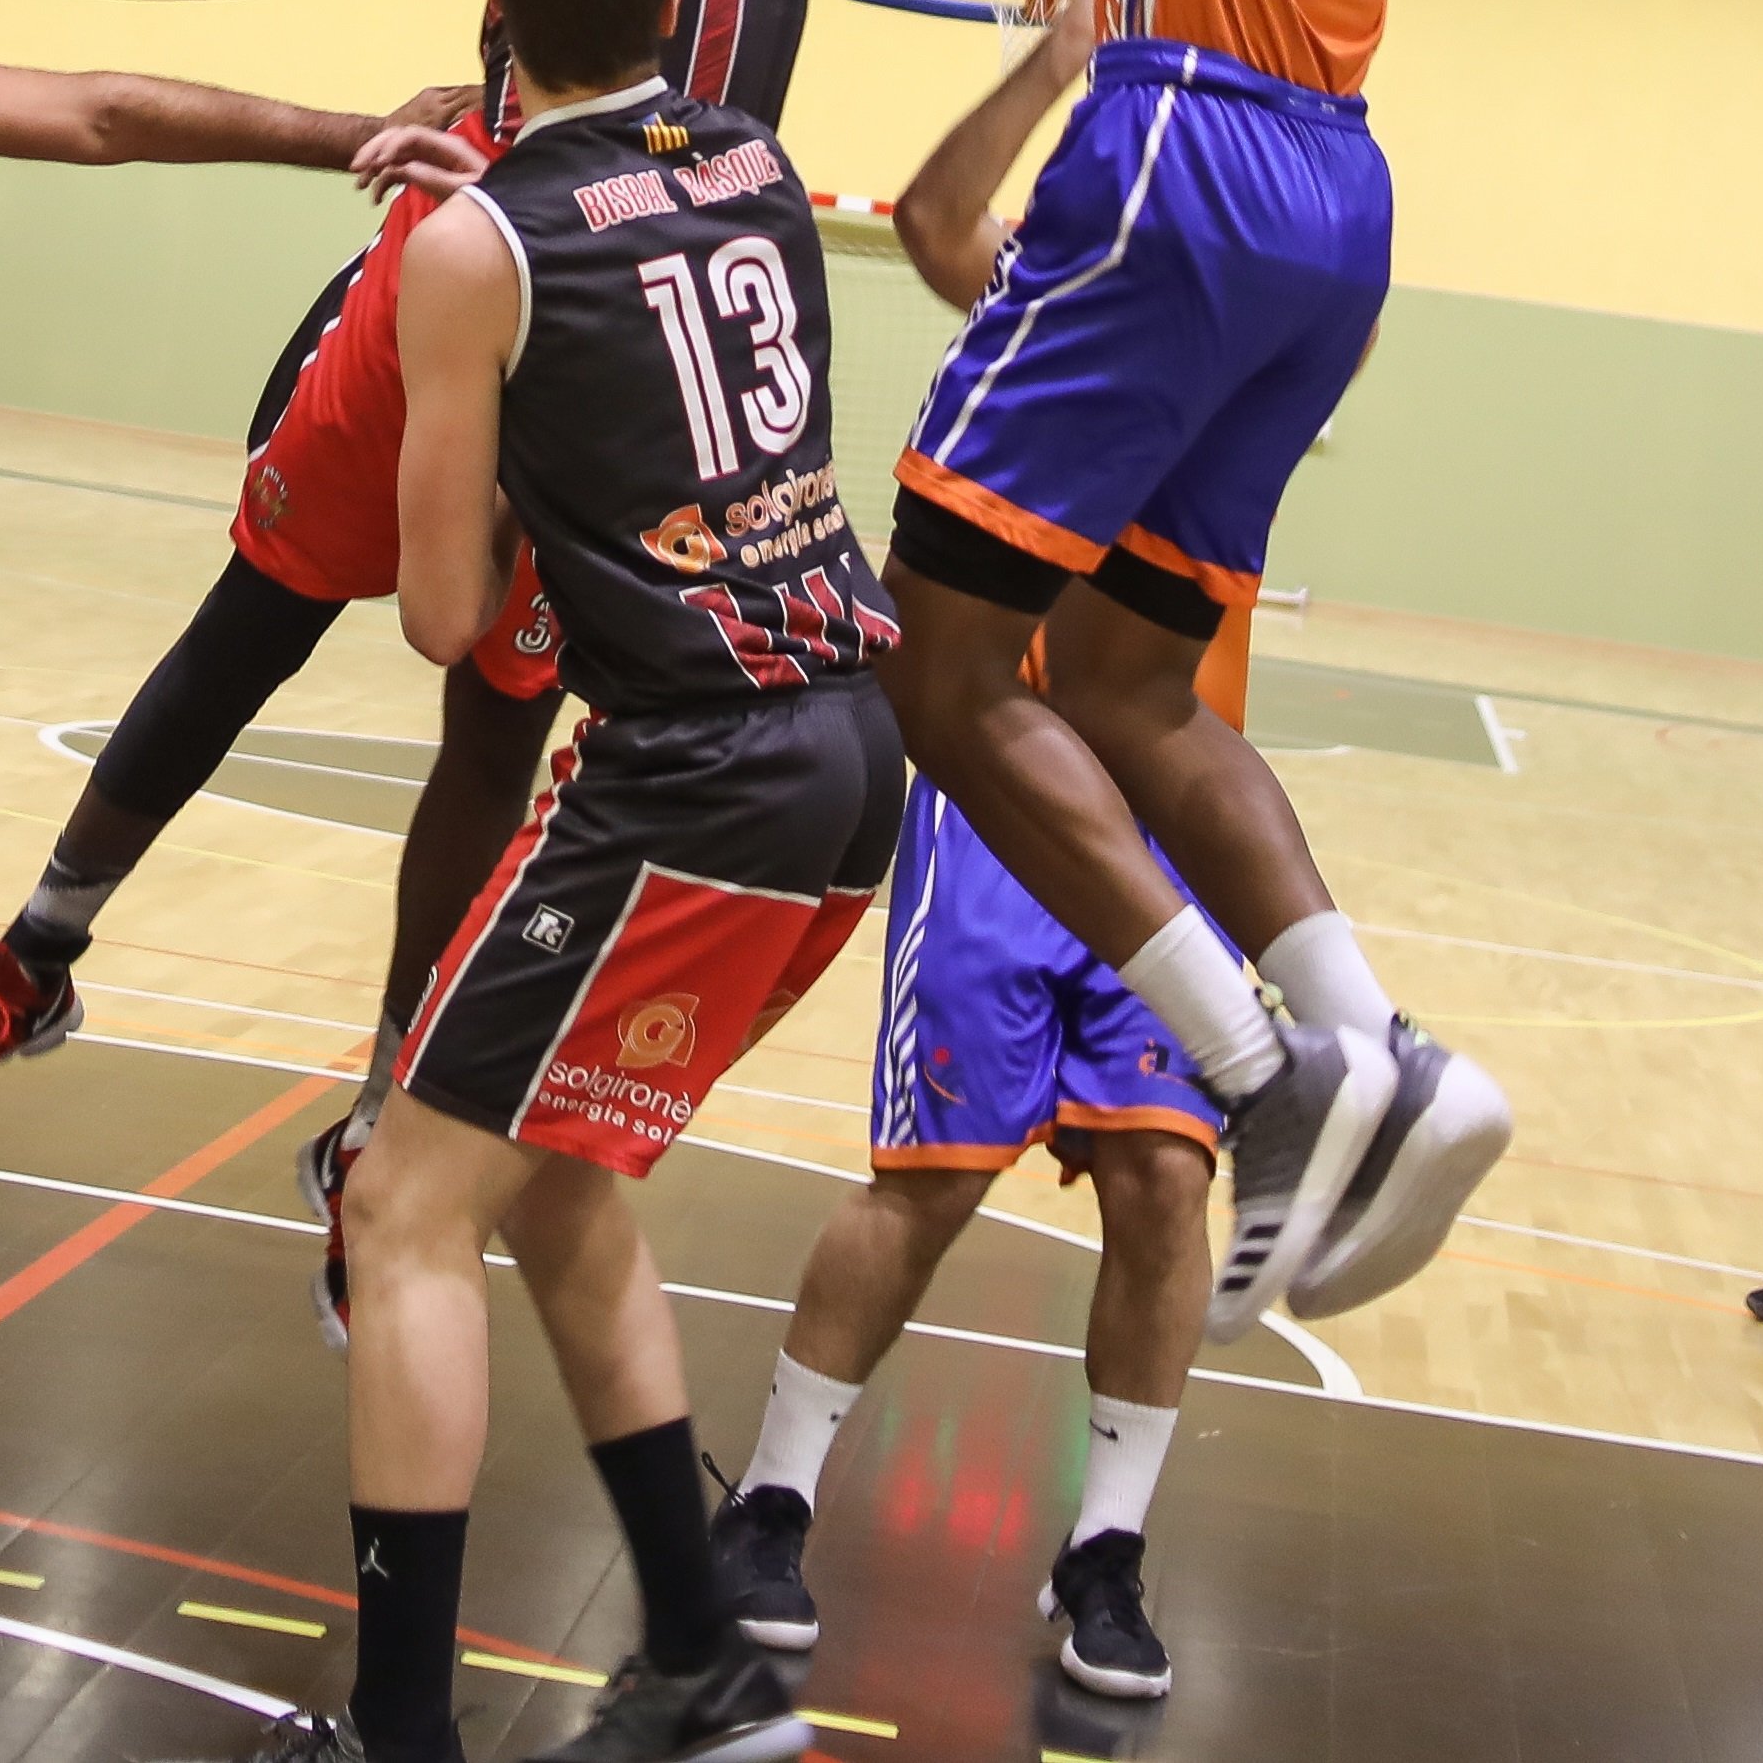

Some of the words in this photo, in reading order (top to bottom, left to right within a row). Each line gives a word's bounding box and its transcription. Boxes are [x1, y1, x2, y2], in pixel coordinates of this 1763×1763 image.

[573, 168, 679, 233] BISBAL
[637, 236, 812, 482] 13
[538, 1090, 627, 1130] energia
